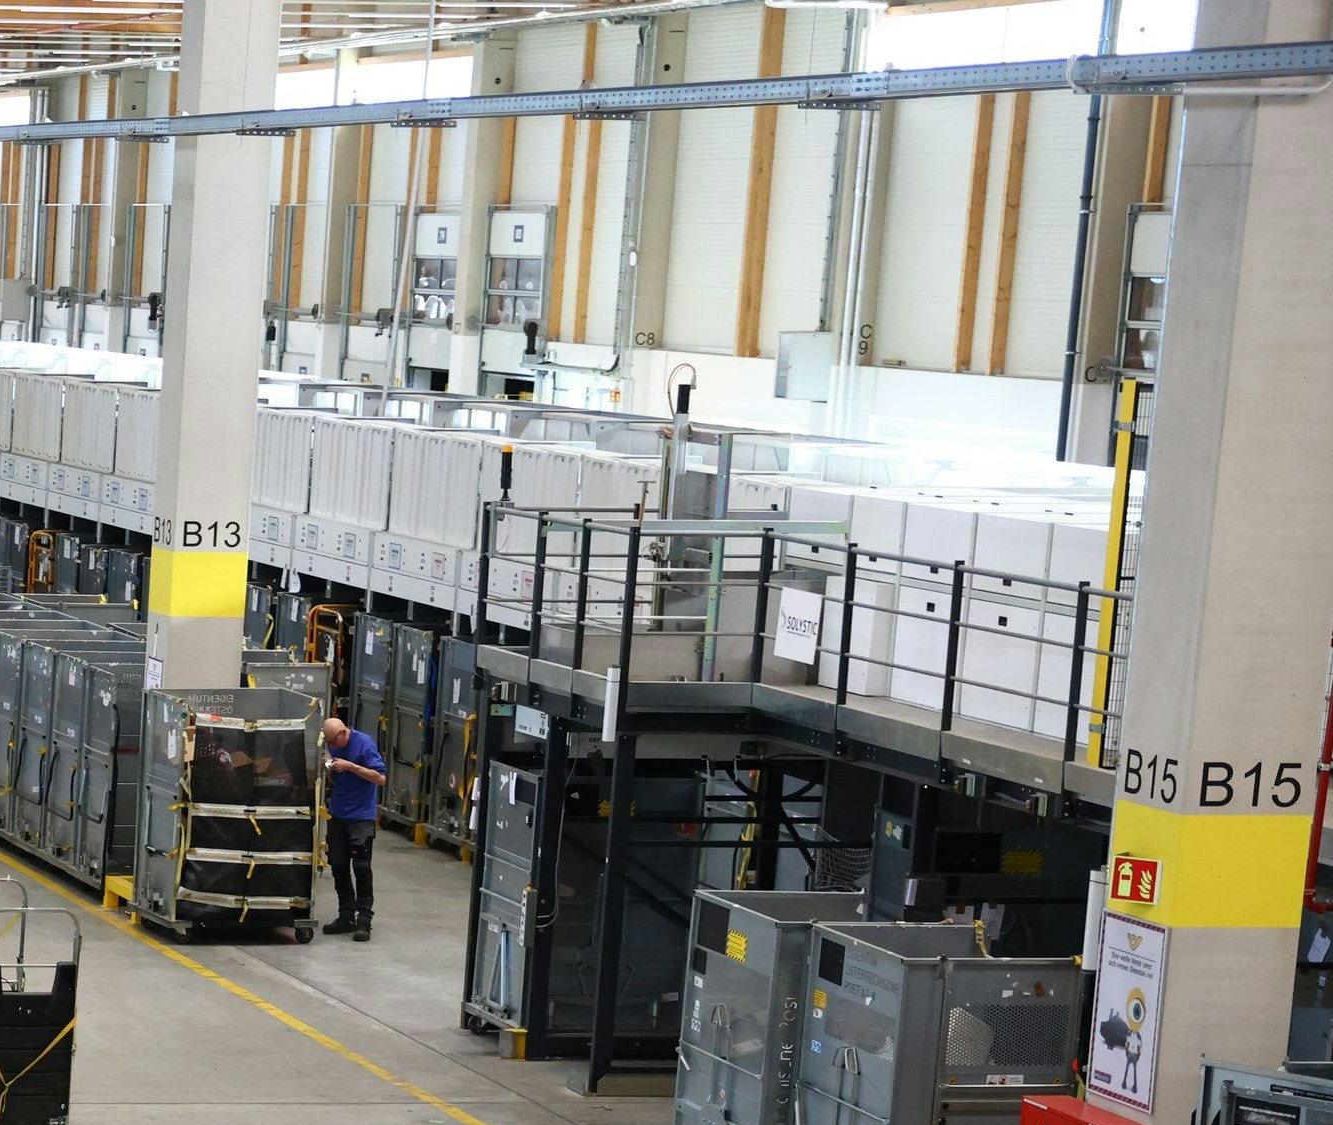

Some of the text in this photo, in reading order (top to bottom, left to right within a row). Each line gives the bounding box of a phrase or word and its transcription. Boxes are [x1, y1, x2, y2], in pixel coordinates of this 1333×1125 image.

[635, 332, 655, 345] C8
[153, 516, 172, 546] B13
[183, 520, 241, 548] B13
[786, 615, 818, 636] SOLYSTIC
[1124, 749, 1179, 803] B15
[1199, 761, 1302, 808] B15
